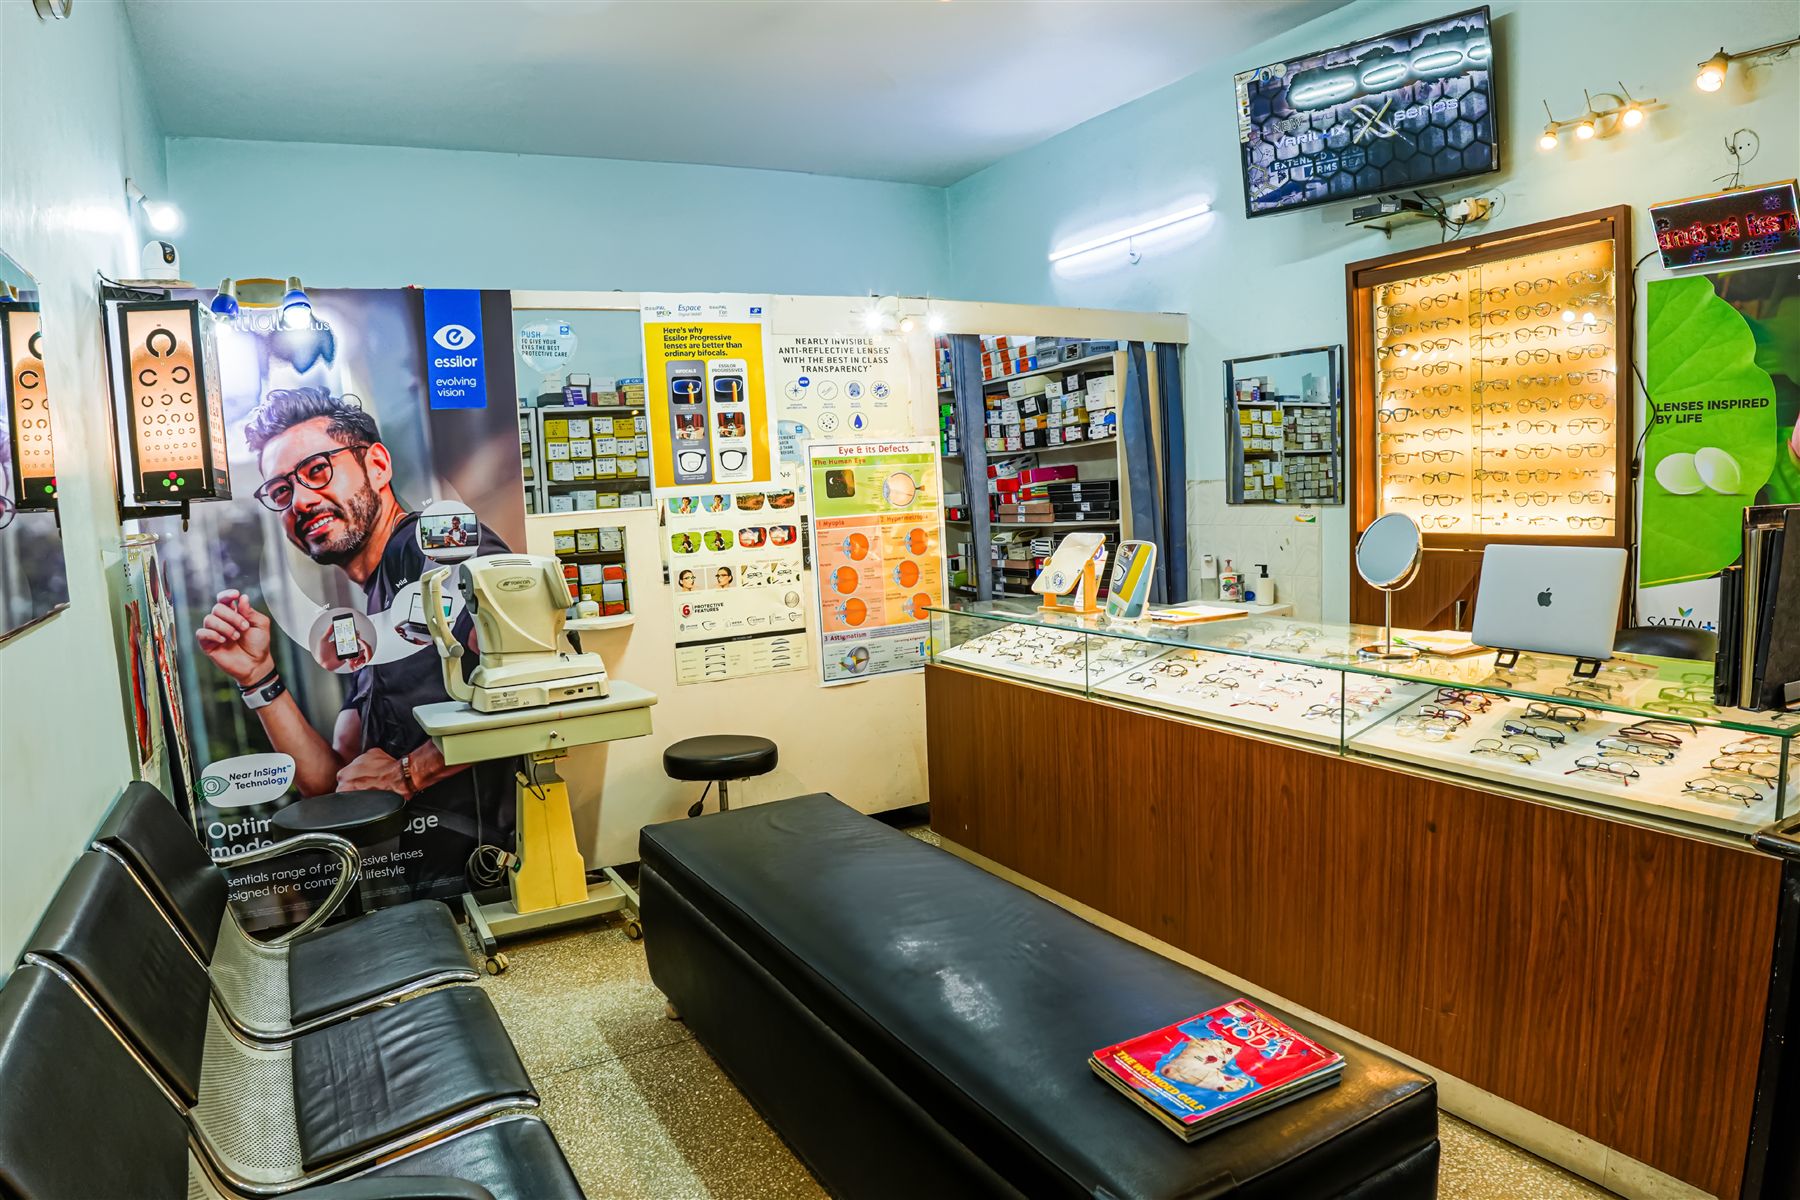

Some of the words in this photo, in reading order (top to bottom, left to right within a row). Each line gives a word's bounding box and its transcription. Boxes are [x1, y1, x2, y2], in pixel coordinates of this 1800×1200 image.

[1394, 99, 1460, 122] series
[521, 330, 541, 338] PUSH
[688, 327, 703, 335] why
[689, 334, 732, 343] Progressive
[795, 337, 829, 345] NEARLY
[831, 337, 873, 346] INVISIBLE
[725, 341, 742, 349] than
[778, 346, 854, 354] ANTI-REFLECTIVE
[664, 349, 696, 358] ordinary
[697, 349, 728, 357] bifocals.
[434, 355, 478, 368] essilor
[782, 356, 805, 364] WITH
[808, 356, 824, 364] THE
[826, 356, 849, 364] BEST
[850, 356, 860, 364] IN
[861, 356, 889, 364] CLASS
[435, 376, 477, 388] evolving
[437, 388, 465, 397] vision
[1656, 401, 1704, 412] LENSES
[1707, 398, 1769, 410] INSPIRED
[1656, 415, 1672, 424] BY
[1675, 413, 1703, 424] LIFE
[838, 446, 854, 456] Eye
[865, 445, 876, 453] its
[878, 444, 910, 453] Defects
[421, 498, 433, 507] Far
[395, 577, 408, 589] Mid
[682, 604, 691, 617] 6
[830, 632, 867, 642] Astigmatism
[229, 771, 252, 782] Near
[235, 775, 288, 791] Technology
[207, 816, 272, 842] Optim
[228, 868, 270, 888] sentials
[271, 866, 307, 881] range
[309, 864, 322, 876] of
[390, 849, 424, 863] lenses
[227, 887, 270, 902] esigned
[272, 885, 290, 896] for
[292, 883, 301, 891] a
[365, 865, 406, 882] lifestyle
[1116, 1050, 1135, 1066] THE
[1132, 1062, 1180, 1095] WOUNDED
[1178, 1093, 1206, 1111] GULF
